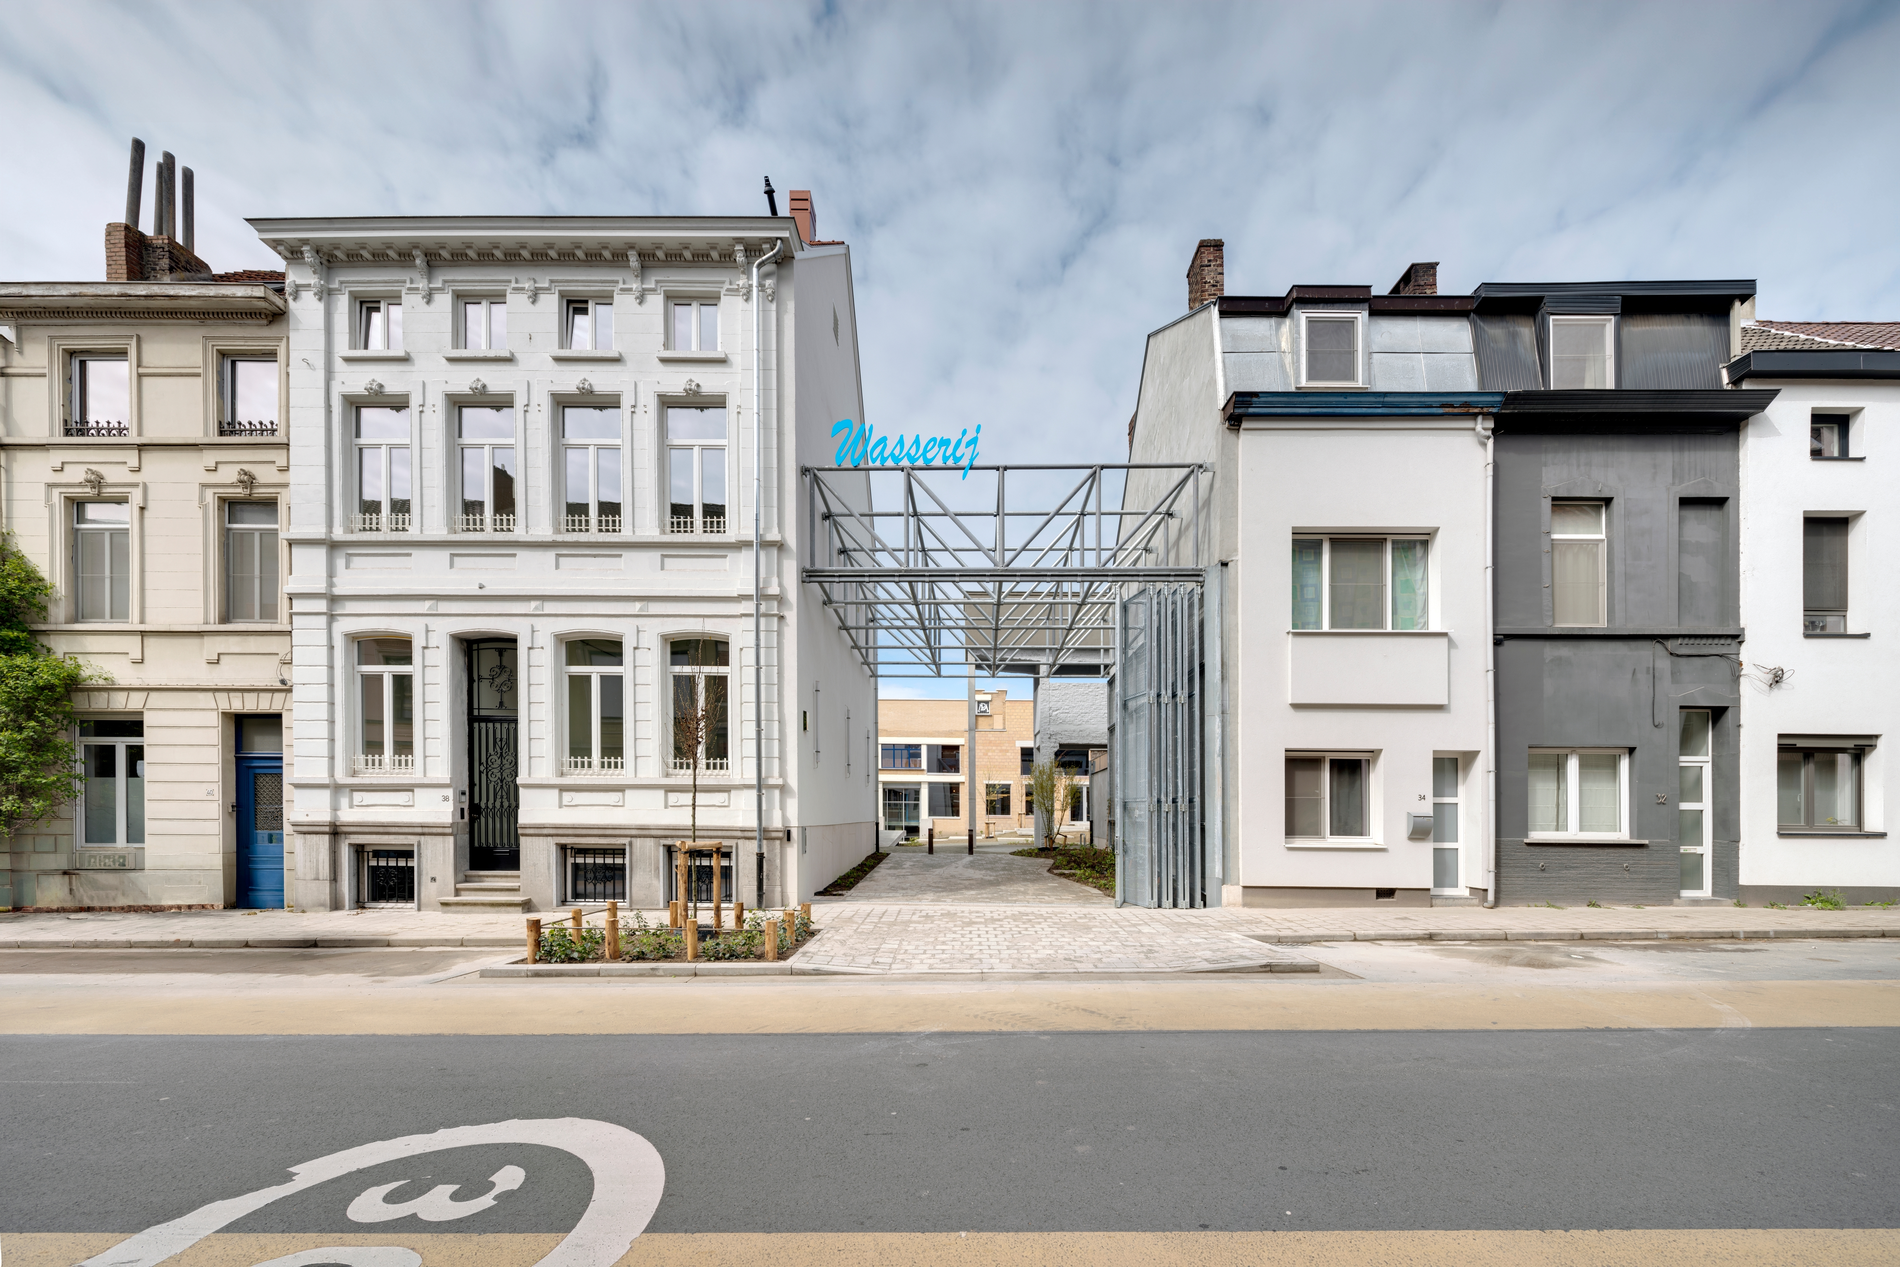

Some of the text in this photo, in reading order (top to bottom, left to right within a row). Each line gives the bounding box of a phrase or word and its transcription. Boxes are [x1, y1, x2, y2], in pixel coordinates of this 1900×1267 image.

[831, 419, 982, 481] Wasserij
[441, 794, 450, 802] 38
[1655, 792, 1667, 805] 32
